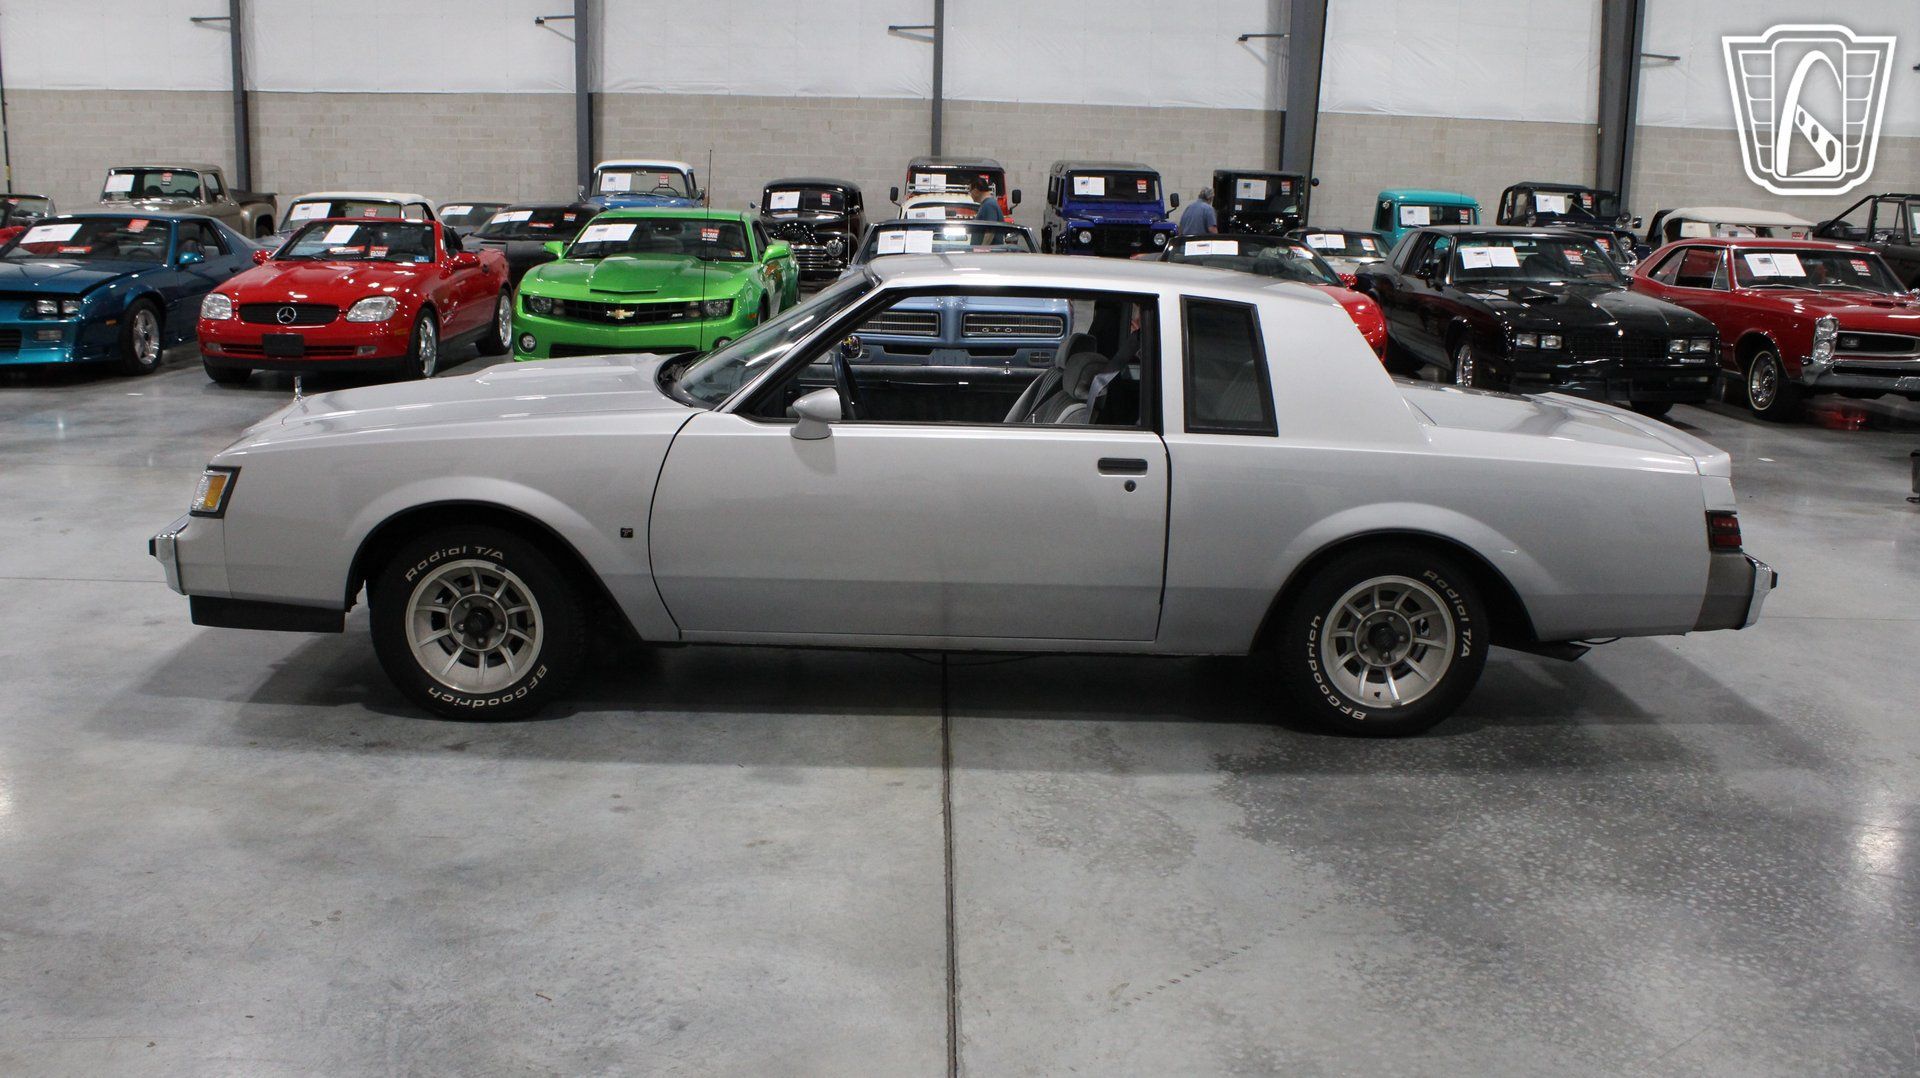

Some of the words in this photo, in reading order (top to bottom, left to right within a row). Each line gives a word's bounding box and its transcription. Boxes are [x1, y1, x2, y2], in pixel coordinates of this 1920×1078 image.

[404, 545, 467, 582] Radial
[474, 545, 505, 561] T/A
[1422, 569, 1472, 623] Radial
[1460, 627, 1472, 658] T/A
[427, 663, 548, 709] BFGoodrich
[1306, 614, 1367, 721] BFGoodrich
